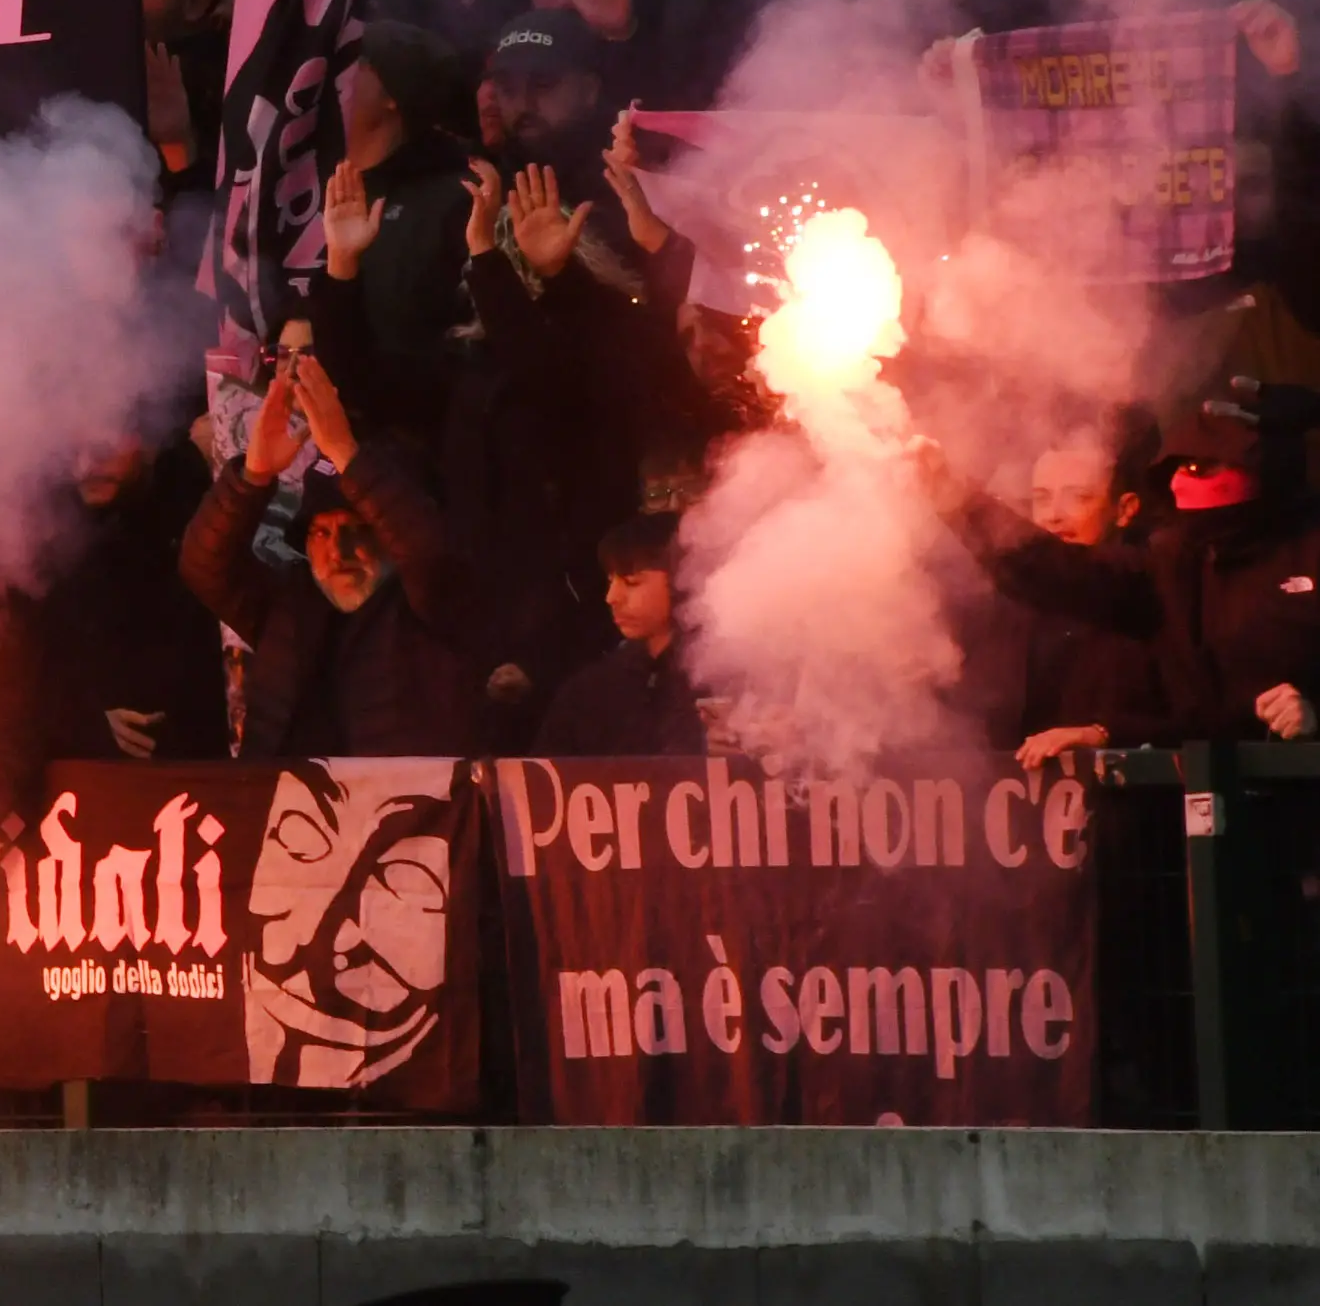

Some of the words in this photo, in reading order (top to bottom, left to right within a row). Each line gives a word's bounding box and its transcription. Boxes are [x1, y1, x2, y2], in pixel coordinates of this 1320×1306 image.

[274, 56, 328, 298] CURV
[497, 758, 647, 878] Per
[666, 758, 790, 868] chi
[807, 777, 964, 868] non
[112, 958, 164, 997] della
[169, 963, 225, 1001] dodici
[560, 968, 688, 1060] ma
[703, 935, 743, 1055] è
[761, 967, 1075, 1081] sempre
